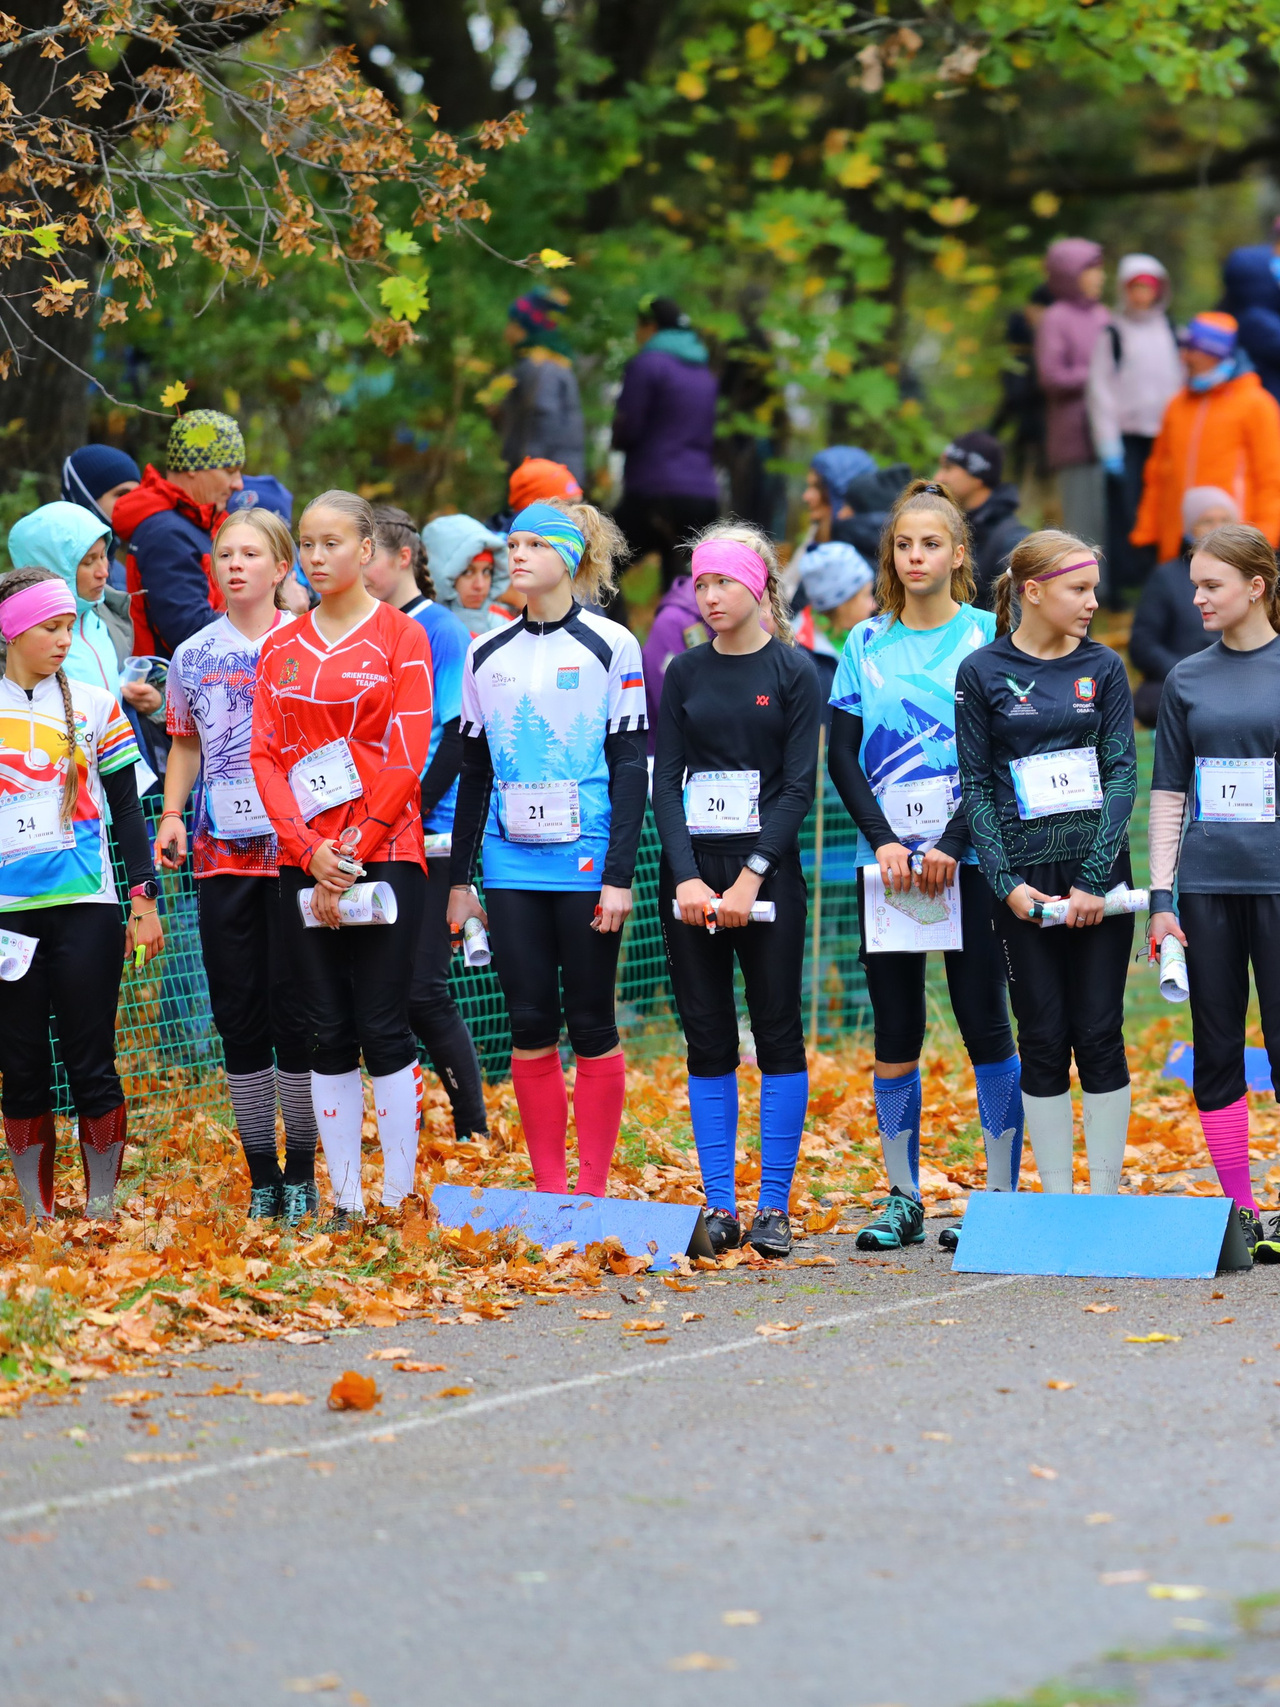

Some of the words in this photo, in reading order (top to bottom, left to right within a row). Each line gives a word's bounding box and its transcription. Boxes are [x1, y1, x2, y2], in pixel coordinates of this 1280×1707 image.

[341, 672, 388, 683] ORIENTEERING
[356, 680, 375, 688] TEAM
[310, 775, 326, 792] 23
[1050, 773, 1069, 788] 18
[1222, 785, 1236, 798] 17
[234, 799, 252, 814] 22
[708, 798, 725, 812] 20
[906, 803, 923, 817] 19
[528, 805, 545, 820] 21
[17, 817, 36, 833] 24
